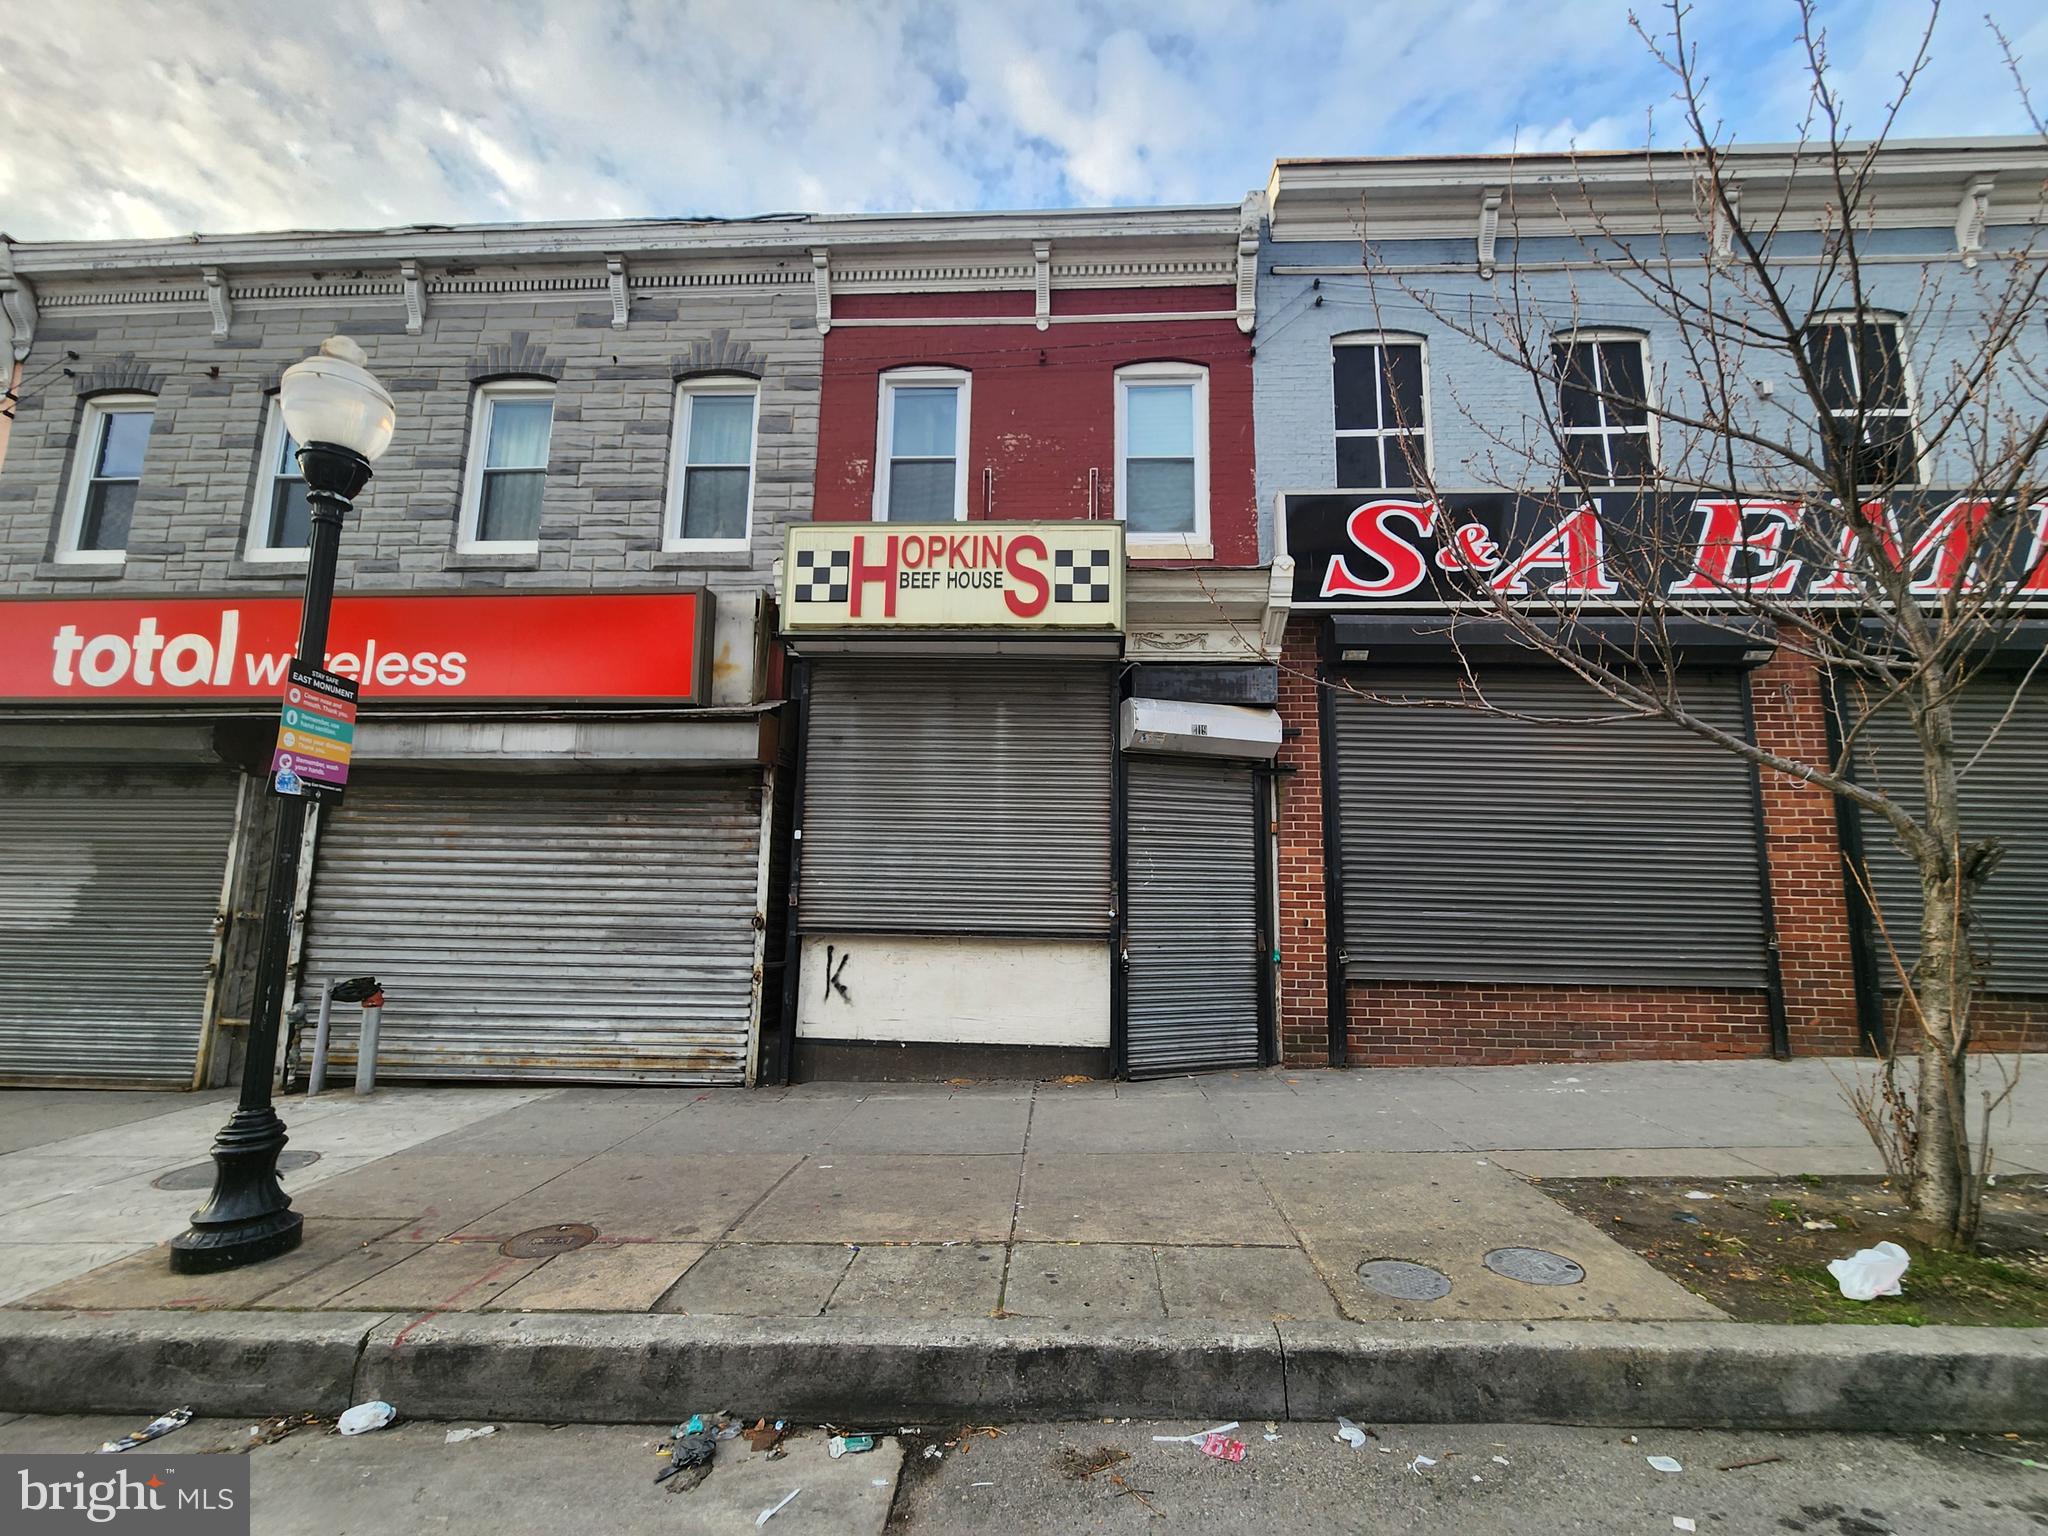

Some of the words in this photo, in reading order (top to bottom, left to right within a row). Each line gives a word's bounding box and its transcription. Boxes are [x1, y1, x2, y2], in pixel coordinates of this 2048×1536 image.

[850, 534, 1050, 618] HOPKINS
[899, 571, 941, 589] BEEF
[947, 571, 1003, 589] HOUSE
[52, 609, 239, 687] total
[245, 639, 467, 686] weless
[292, 672, 312, 685] EAST
[313, 679, 354, 699] MONUMENT
[312, 670, 325, 680] STAY
[325, 675, 339, 685] SAFE
[824, 945, 852, 1005] K
